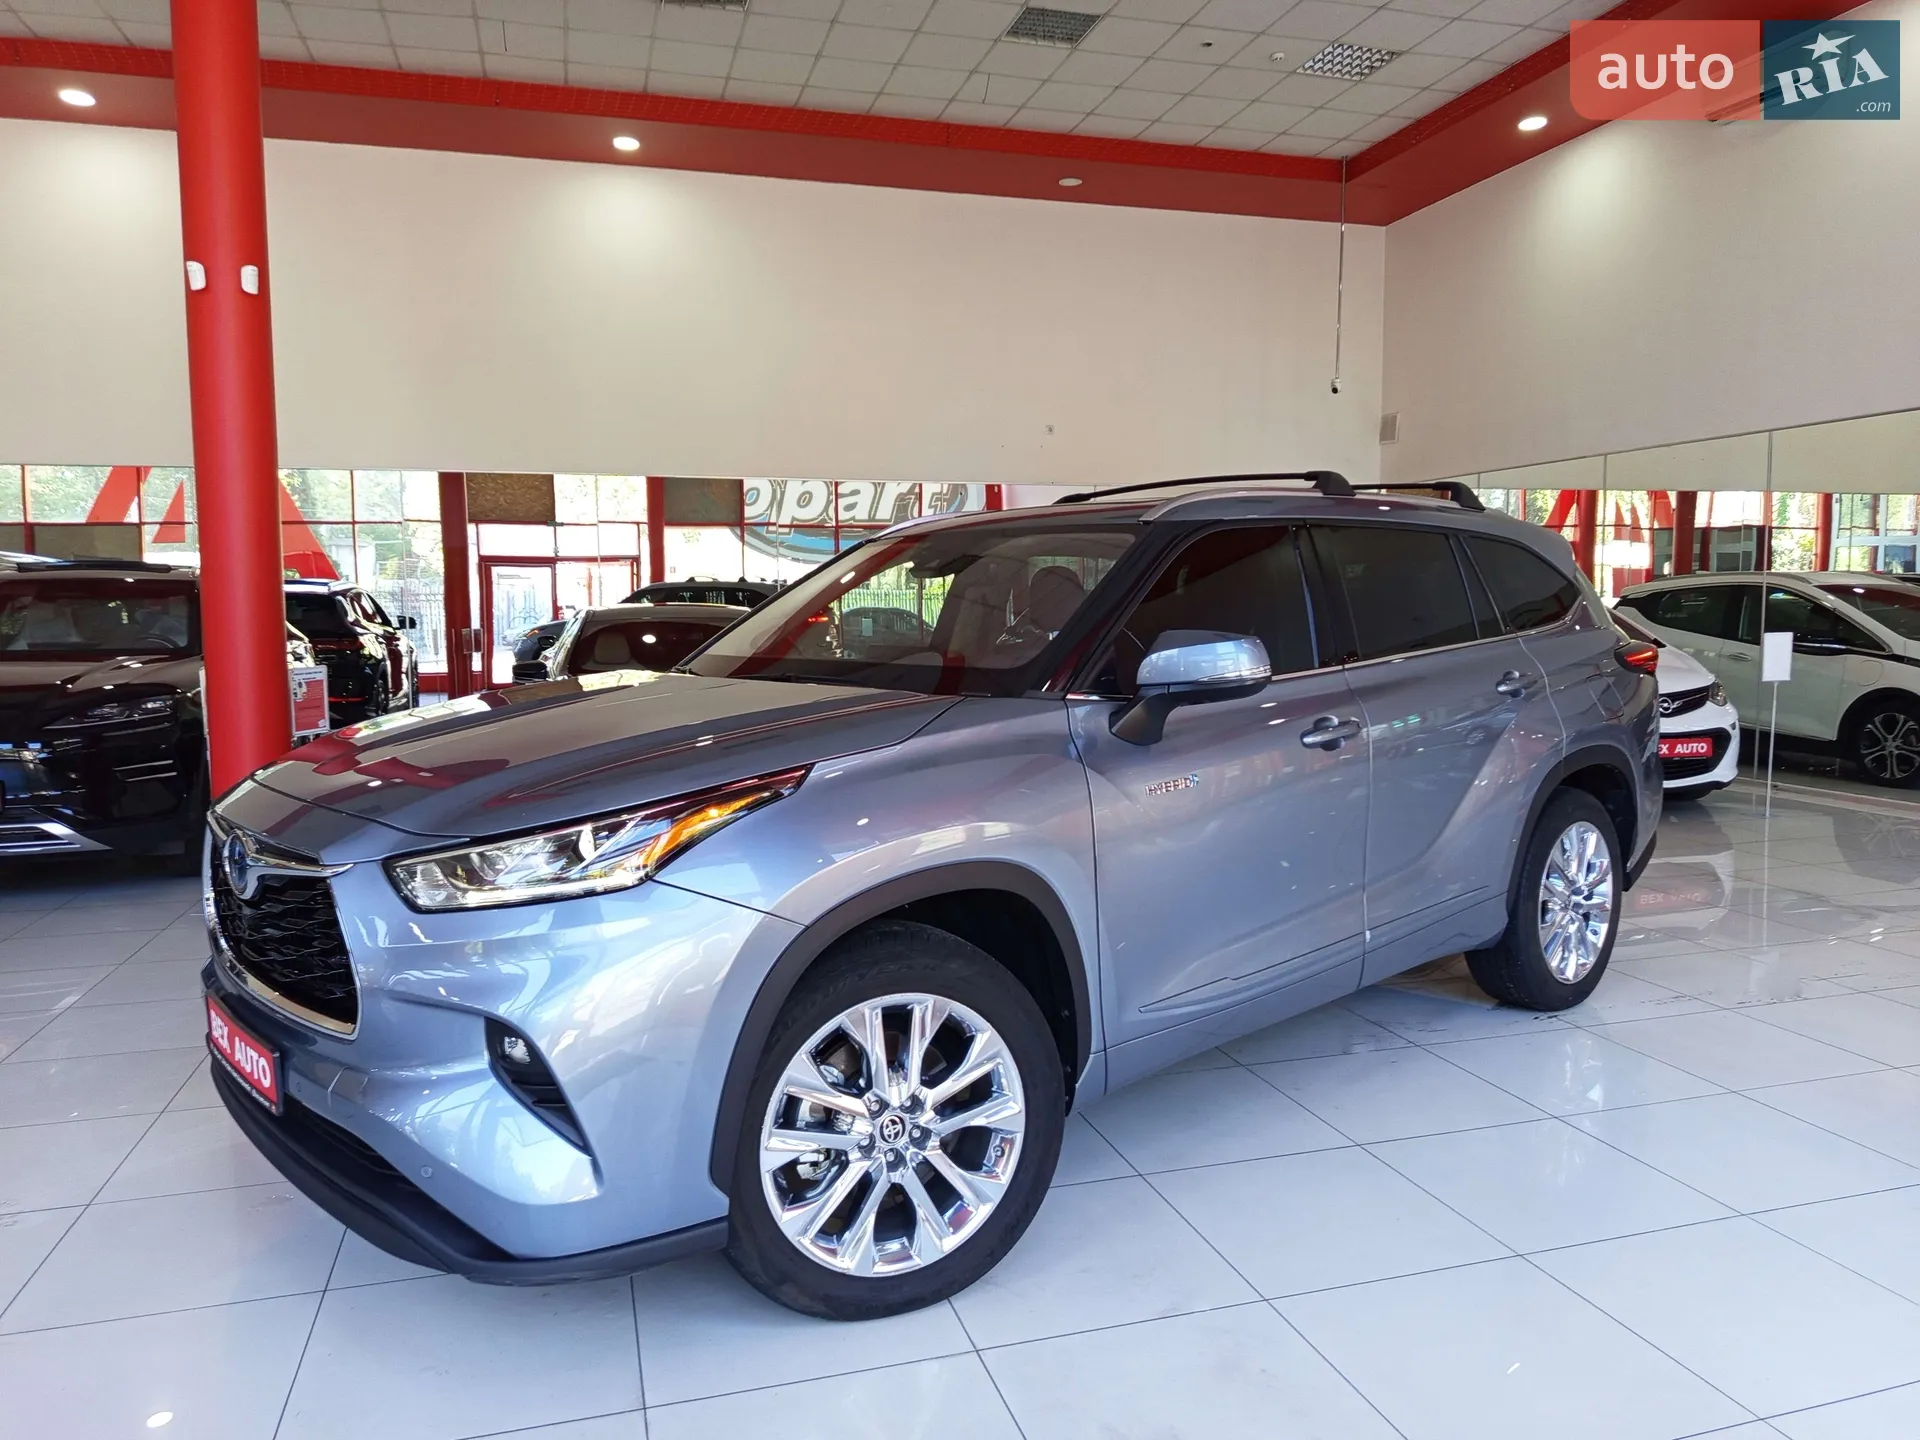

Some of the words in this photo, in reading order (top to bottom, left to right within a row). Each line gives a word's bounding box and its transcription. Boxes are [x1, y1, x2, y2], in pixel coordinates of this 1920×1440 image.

[1674, 742, 1708, 754] AUTO
[1144, 777, 1193, 797] HYBRID
[234, 1036, 272, 1088] AUTO
